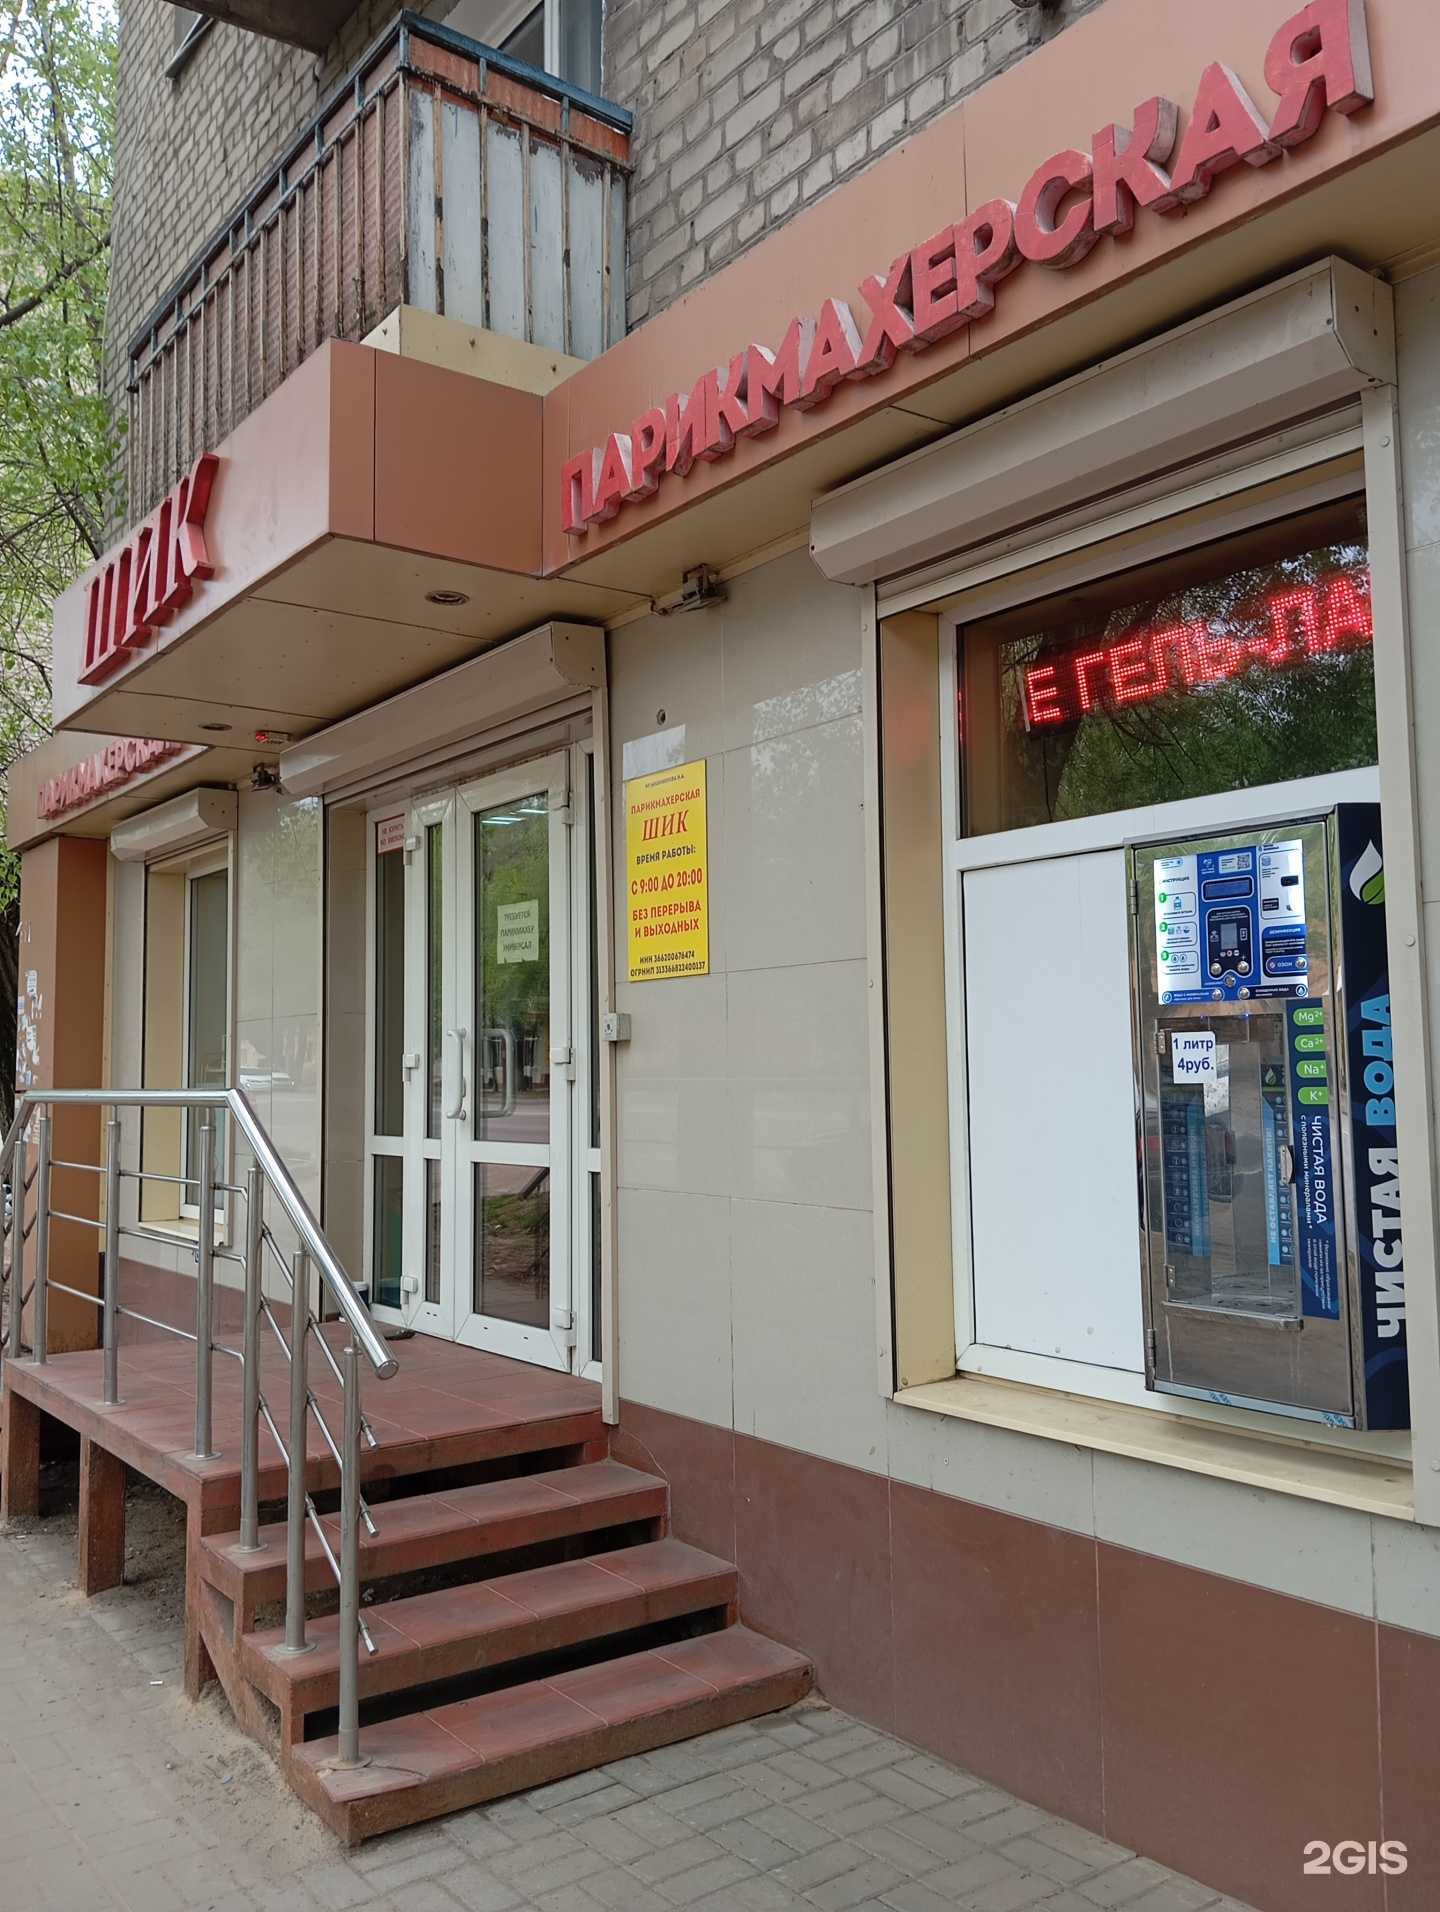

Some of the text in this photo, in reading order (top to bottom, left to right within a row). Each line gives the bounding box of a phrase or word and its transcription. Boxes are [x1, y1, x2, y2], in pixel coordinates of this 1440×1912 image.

[561, 0, 1375, 535] ПАРИКМАХЕРСКАЯ
[78, 452, 219, 685] ШИК
[631, 788, 701, 814] ПАРИКМАХЕРСКАЯ
[642, 810, 689, 842] ШИК
[636, 844, 697, 865] ВРЕМЯ РАБОТЫ:
[631, 868, 703, 895] С 9:00 ДО 20:00
[632, 900, 701, 921] БЕЗ ПЕРЕРЫВА
[635, 918, 699, 938] И ВЫХОДНЫХ
[639, 954, 653, 964] ИНН
[1173, 1038, 1214, 1053] 1 литр
[1177, 1057, 1214, 1074] 4руб.
[1311, 1115, 1325, 1175] ЧИСТАЯ
[1361, 994, 1406, 1339] ЧИСТАЯ ВОДА
[1313, 1179, 1328, 1224] ВОДА
